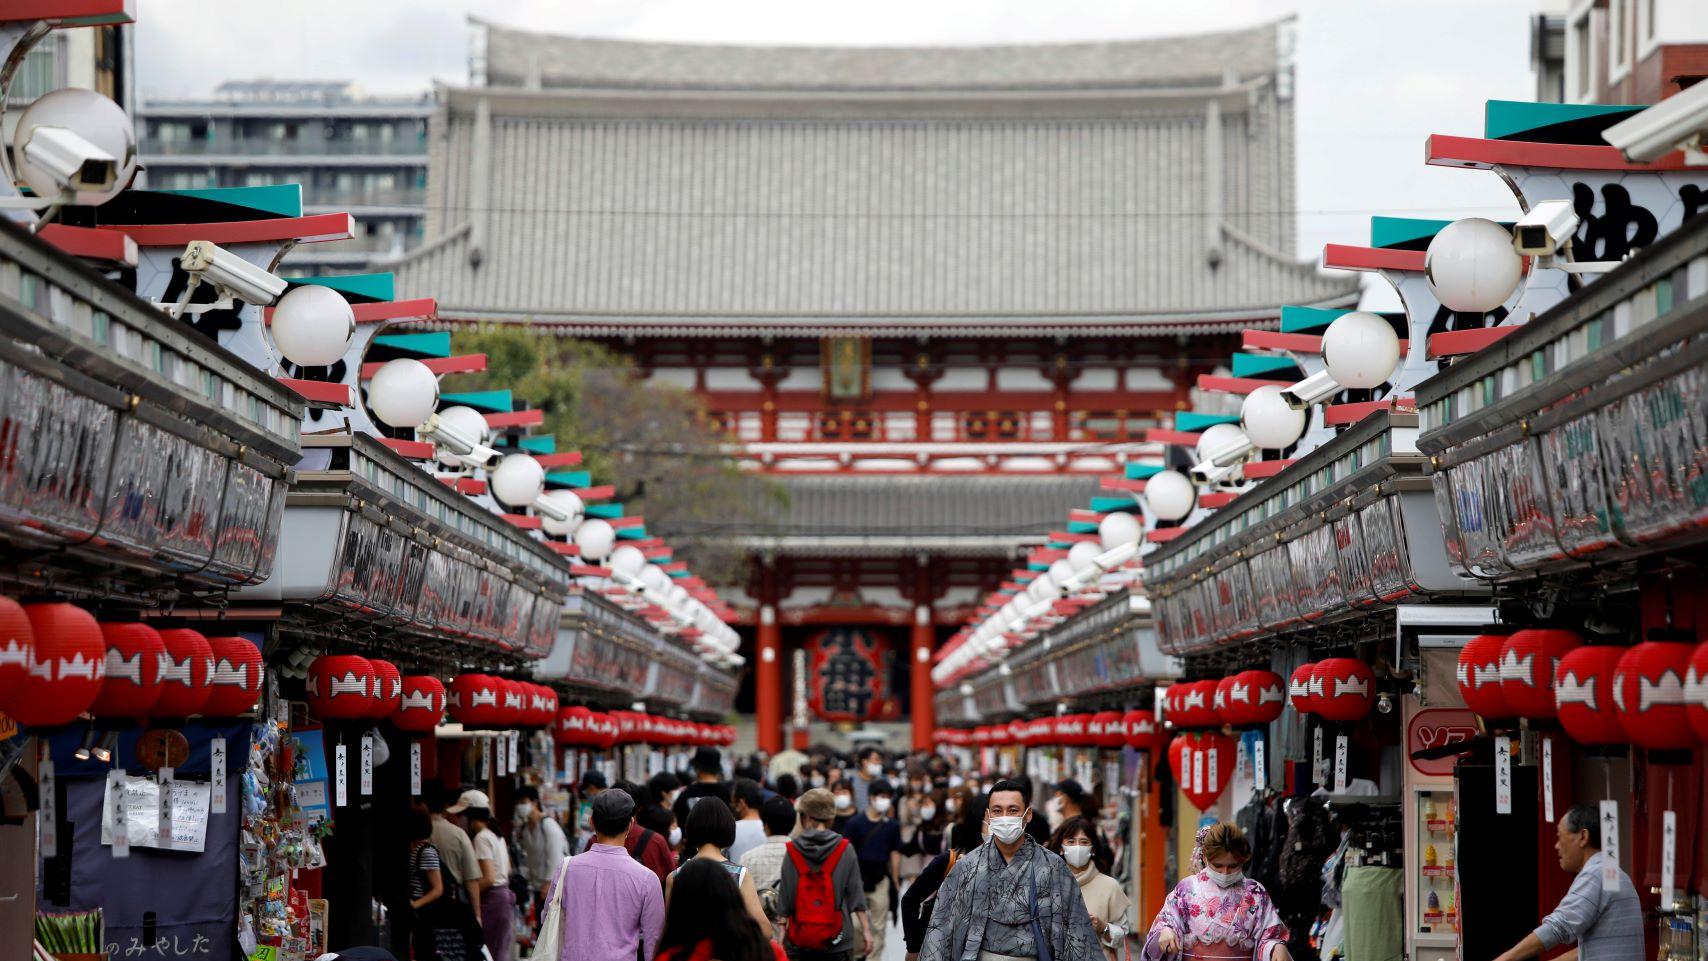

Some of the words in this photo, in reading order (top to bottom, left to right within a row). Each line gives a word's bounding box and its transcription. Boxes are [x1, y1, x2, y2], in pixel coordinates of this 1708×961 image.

[105, 933, 210, 957] のみやした
